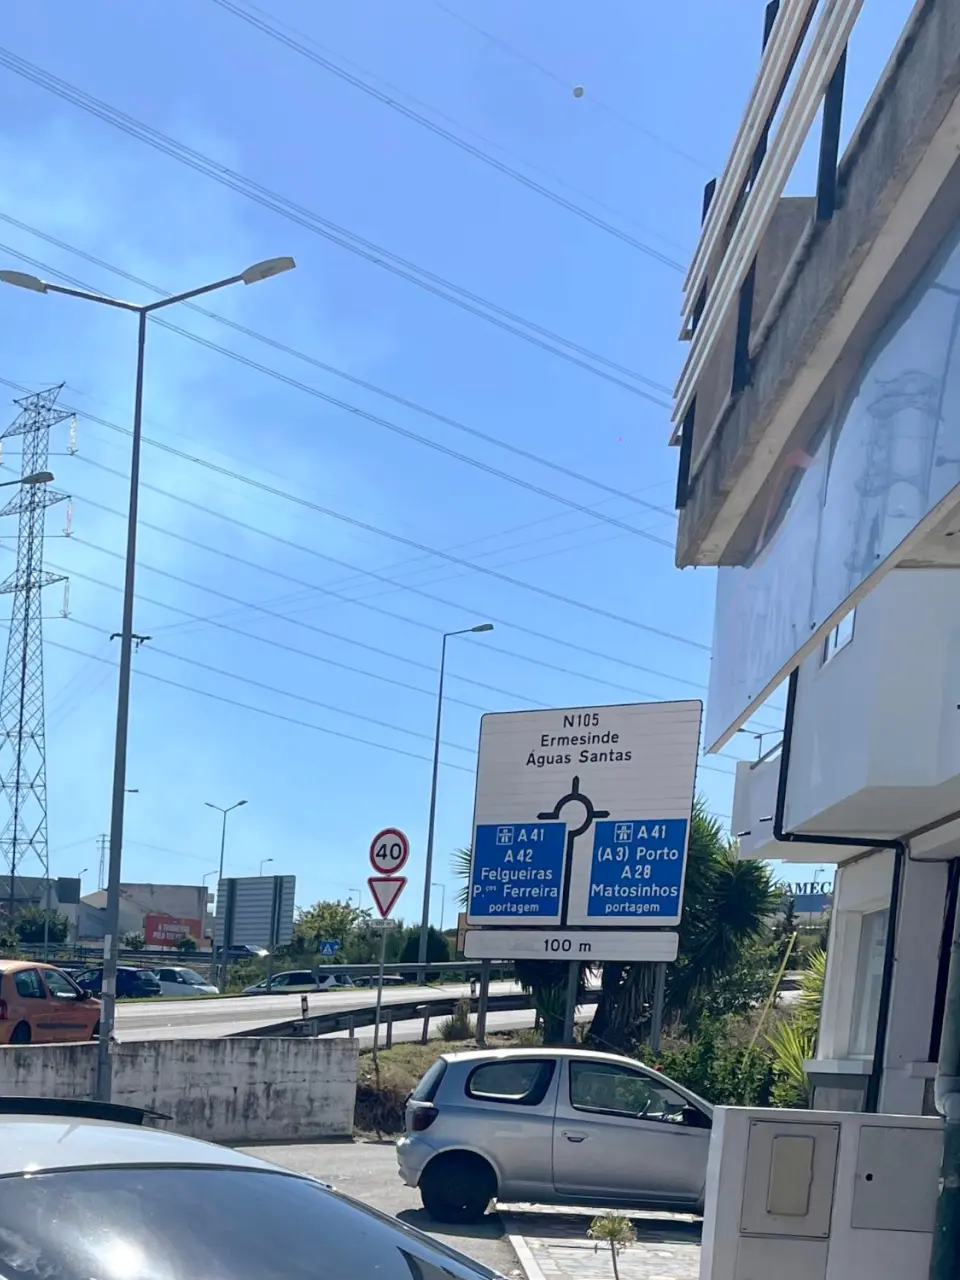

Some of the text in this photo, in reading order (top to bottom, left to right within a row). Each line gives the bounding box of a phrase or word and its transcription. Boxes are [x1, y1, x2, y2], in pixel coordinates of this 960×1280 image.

[541, 731, 619, 747] Ermesinde
[526, 749, 632, 768] Águas Santas
[376, 843, 402, 860] 40
[636, 846, 679, 861] Porto
[481, 867, 553, 882] Felgueiras
[503, 884, 558, 898] Ferreira
[591, 883, 679, 897] Matosinhos
[489, 902, 539, 914] portagem
[605, 902, 660, 914] portagem
[544, 939, 592, 952] 100 m
